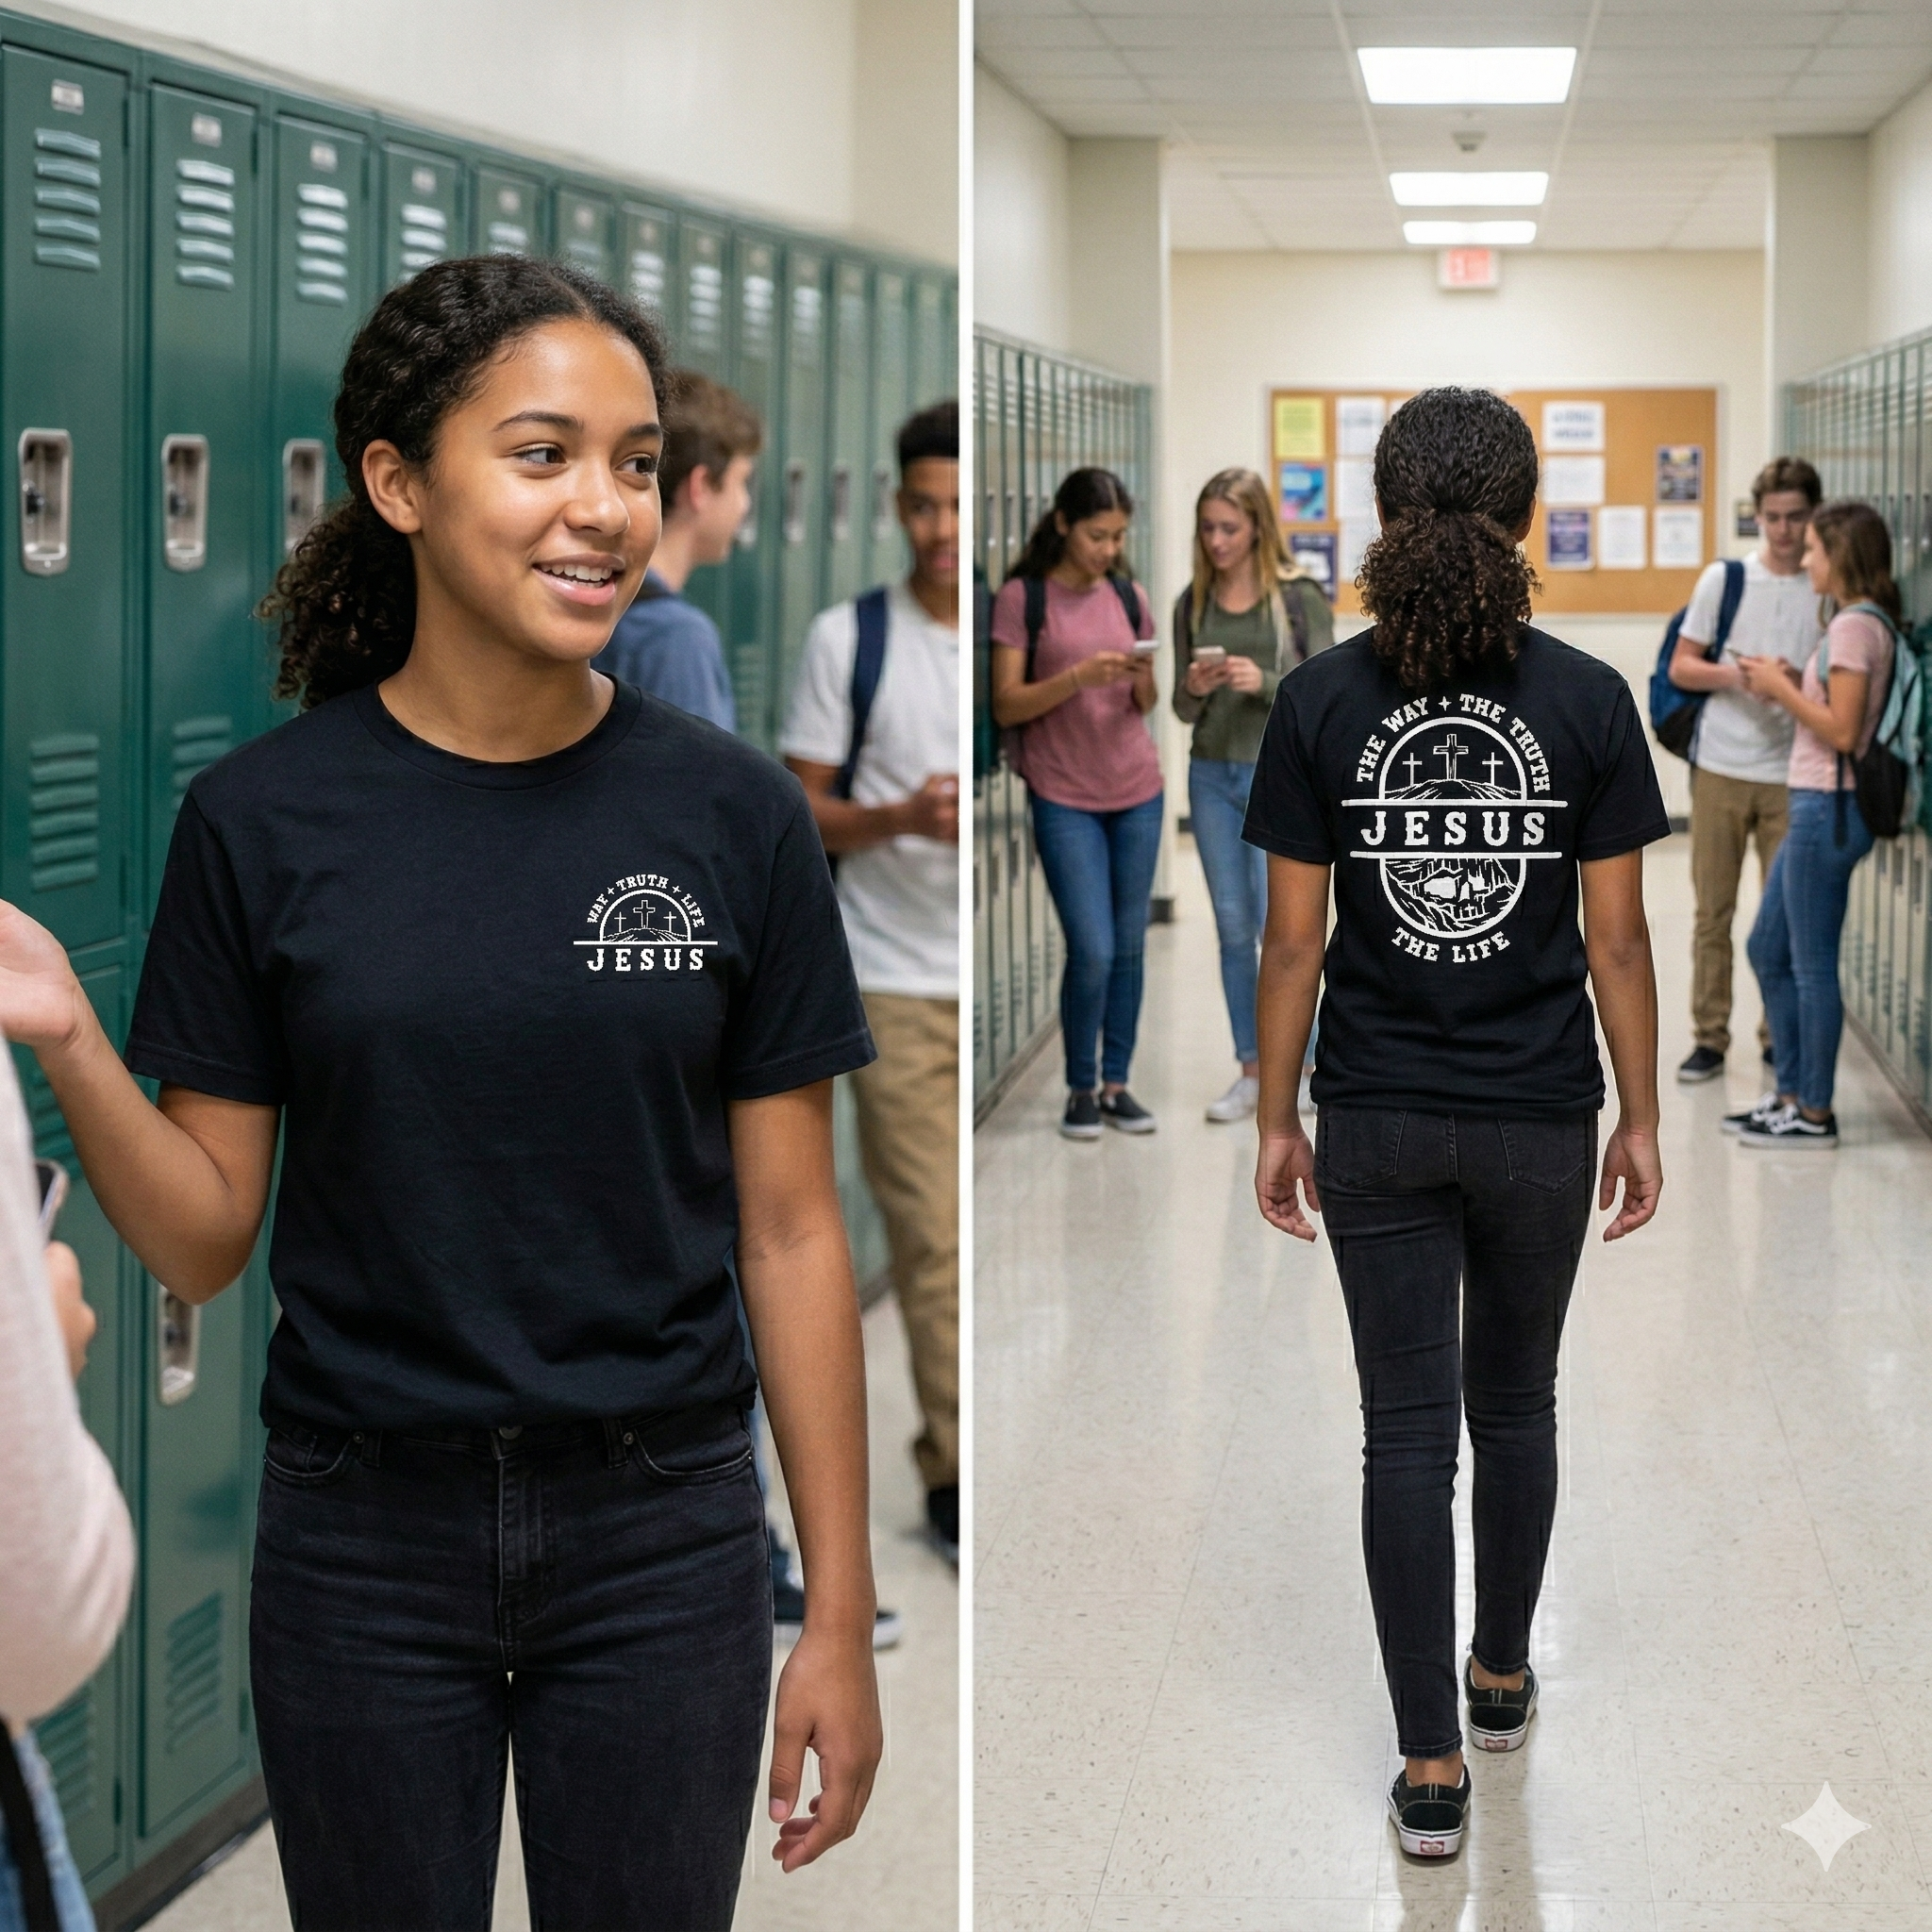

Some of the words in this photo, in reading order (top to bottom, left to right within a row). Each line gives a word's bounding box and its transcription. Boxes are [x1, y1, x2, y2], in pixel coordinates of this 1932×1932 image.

[1356, 735, 1387, 783] THE
[1381, 696, 1429, 733] WAY
[1458, 693, 1507, 724] THE
[1509, 716, 1551, 793] TRUTH
[1360, 810, 1545, 847] JESUS
[615, 874, 670, 891] TRUTH
[680, 892, 706, 928] LIFE
[586, 947, 704, 973] JESUS
[1391, 925, 1441, 962] THE
[1451, 930, 1511, 963] LIFE
